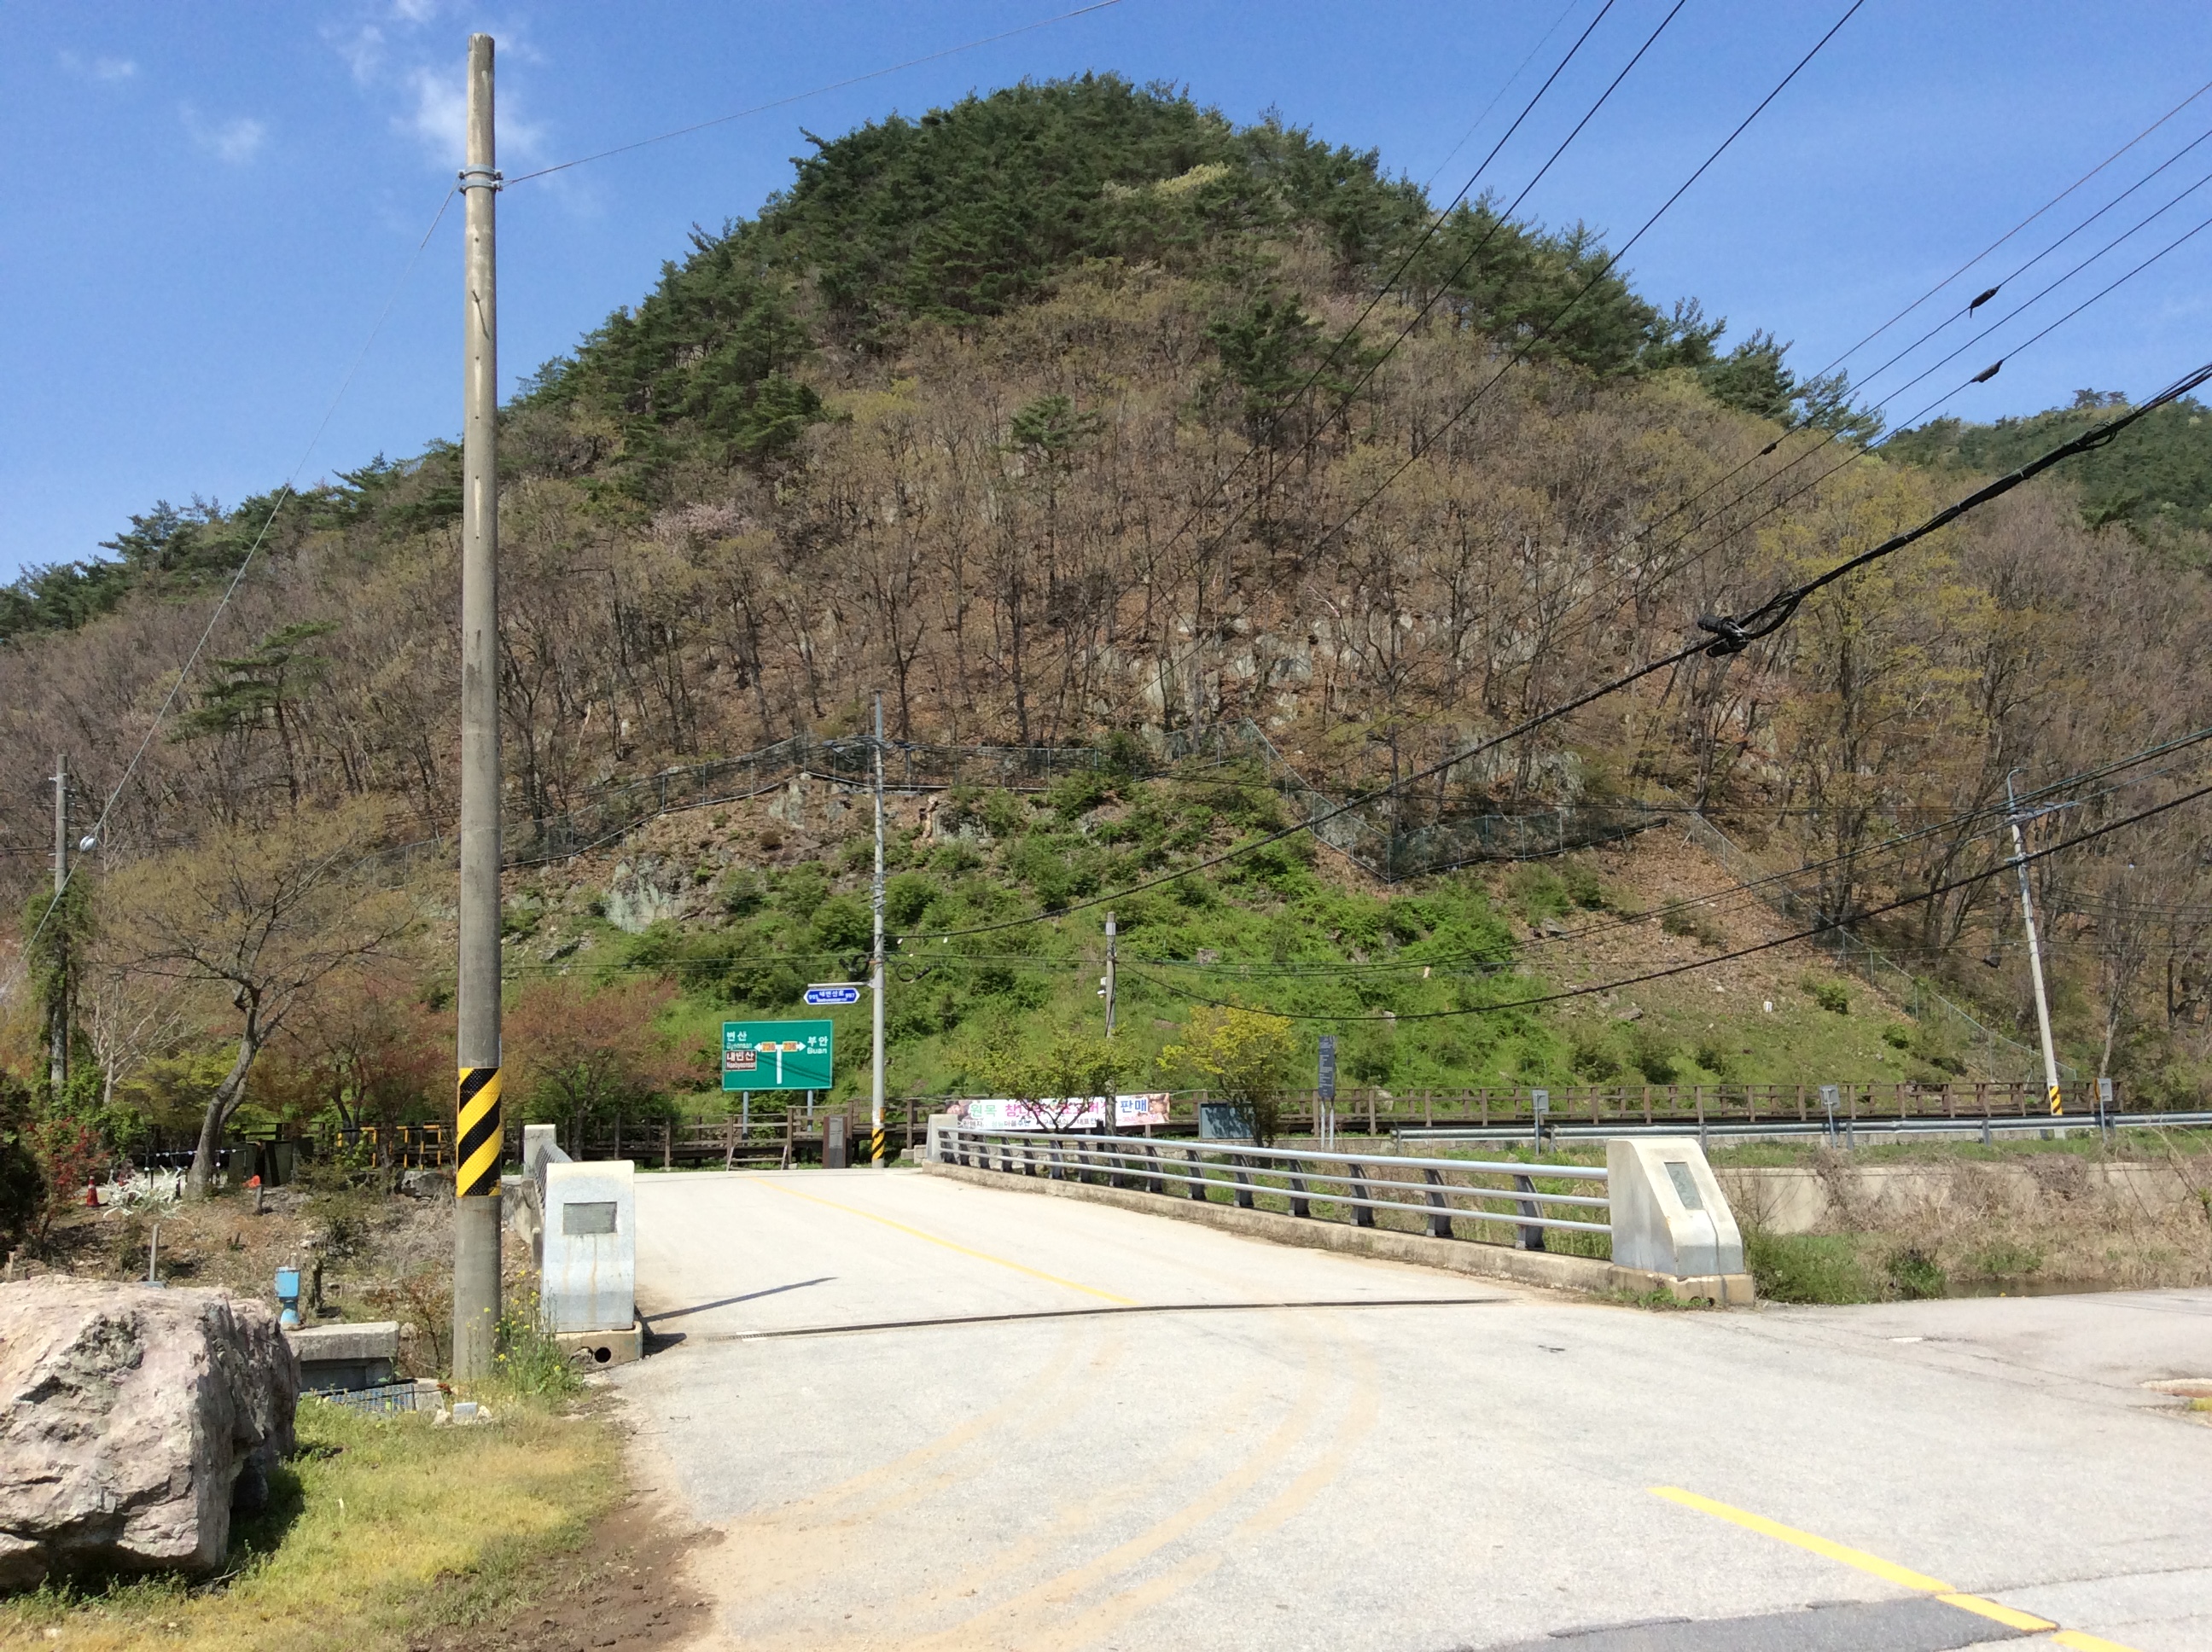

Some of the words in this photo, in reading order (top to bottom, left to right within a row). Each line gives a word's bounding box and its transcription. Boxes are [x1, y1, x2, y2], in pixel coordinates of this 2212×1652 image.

[726, 1031, 747, 1042] 변산
[807, 1036, 829, 1047] 부안
[726, 1050, 754, 1062] 내변산
[970, 1104, 997, 1118] 원목
[1120, 1099, 1147, 1114] 판매
